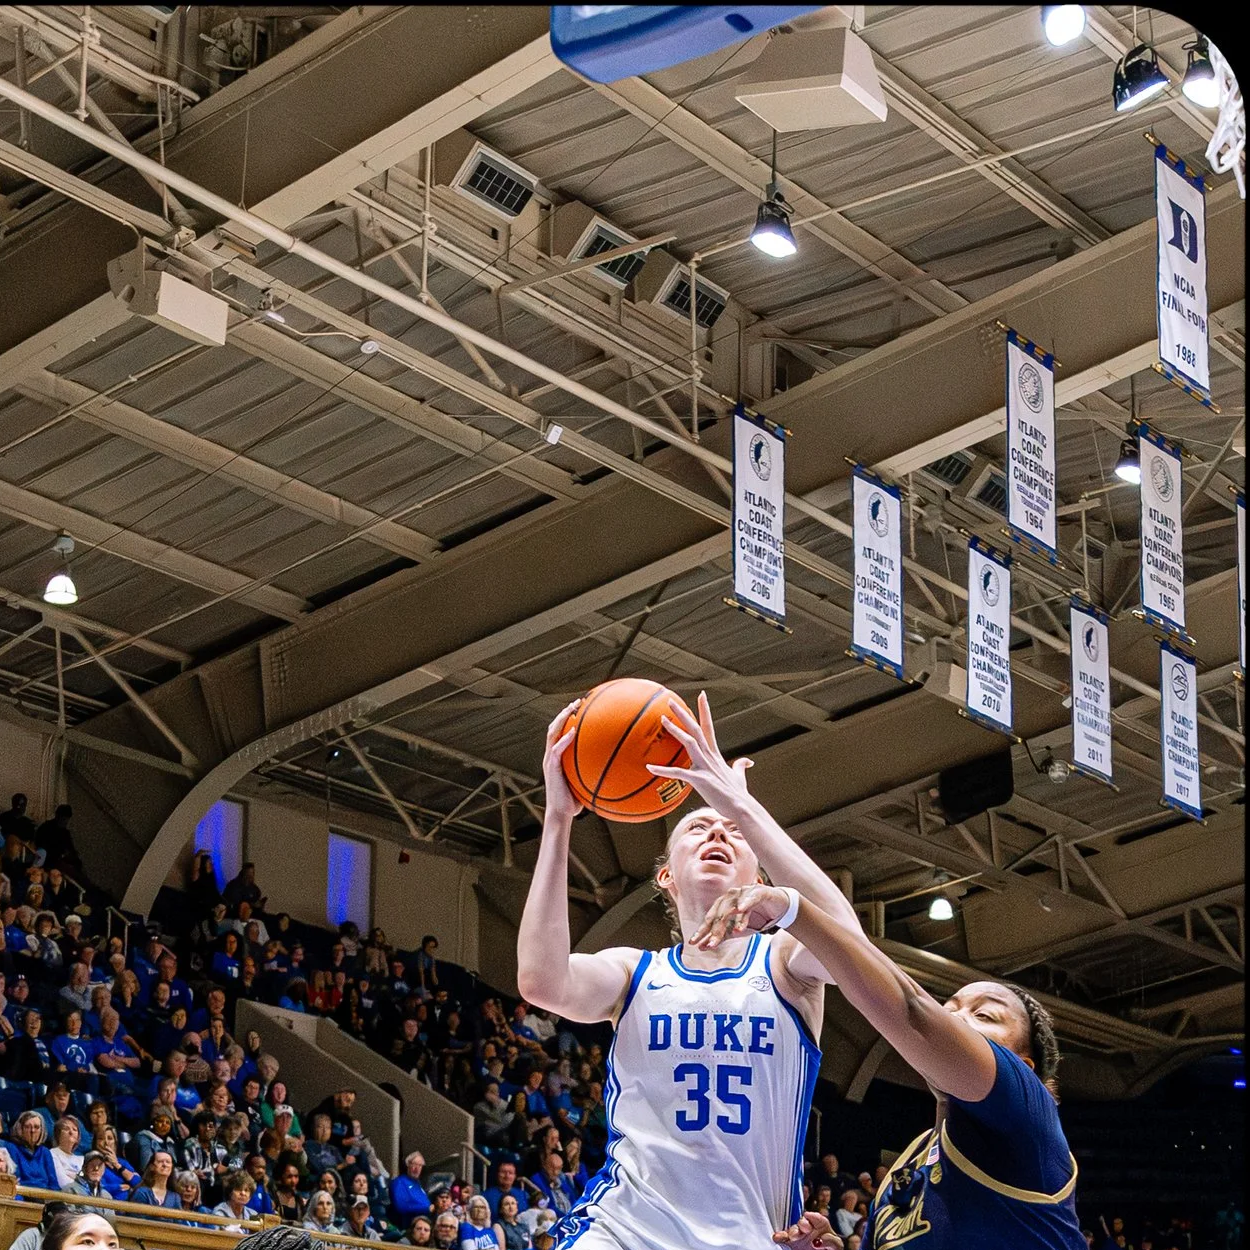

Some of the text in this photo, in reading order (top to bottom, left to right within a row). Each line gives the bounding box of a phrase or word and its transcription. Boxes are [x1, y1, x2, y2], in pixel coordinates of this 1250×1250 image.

[1174, 272, 1196, 301] NCAA
[1161, 290, 1206, 335] FINAL FOUR
[1175, 343, 1196, 368] 1988
[1018, 418, 1047, 449] ATLANTIC
[1022, 438, 1043, 461] COAST
[1011, 447, 1054, 486] CONFERENCE
[1013, 466, 1053, 502] CHAMPIONS
[743, 489, 777, 518] ATLANTIC
[748, 508, 773, 532] COAST
[1024, 509, 1043, 532] 1964
[1150, 507, 1176, 534] ATLANTIC
[737, 518, 785, 554] CONFERENCE
[1154, 525, 1173, 546] COAST
[739, 536, 783, 570] CHAMPIONS
[862, 546, 895, 572] ATLANTIC
[1144, 535, 1183, 568] CONFERENCE
[869, 563, 890, 585] COAST
[1146, 552, 1182, 583] CHAMPIONS
[855, 574, 900, 606] CONFERENCE
[857, 591, 899, 621] CHAMPIONS
[870, 630, 889, 650] 2009
[975, 613, 1005, 639] ATLANTIC
[970, 640, 1010, 672] CONFERENCE
[971, 657, 1009, 685] CHAMPIONS
[981, 694, 1002, 713] 2010
[1087, 747, 1104, 764] 2011
[648, 1013, 775, 1056] DUKE
[673, 1063, 753, 1136] 35
